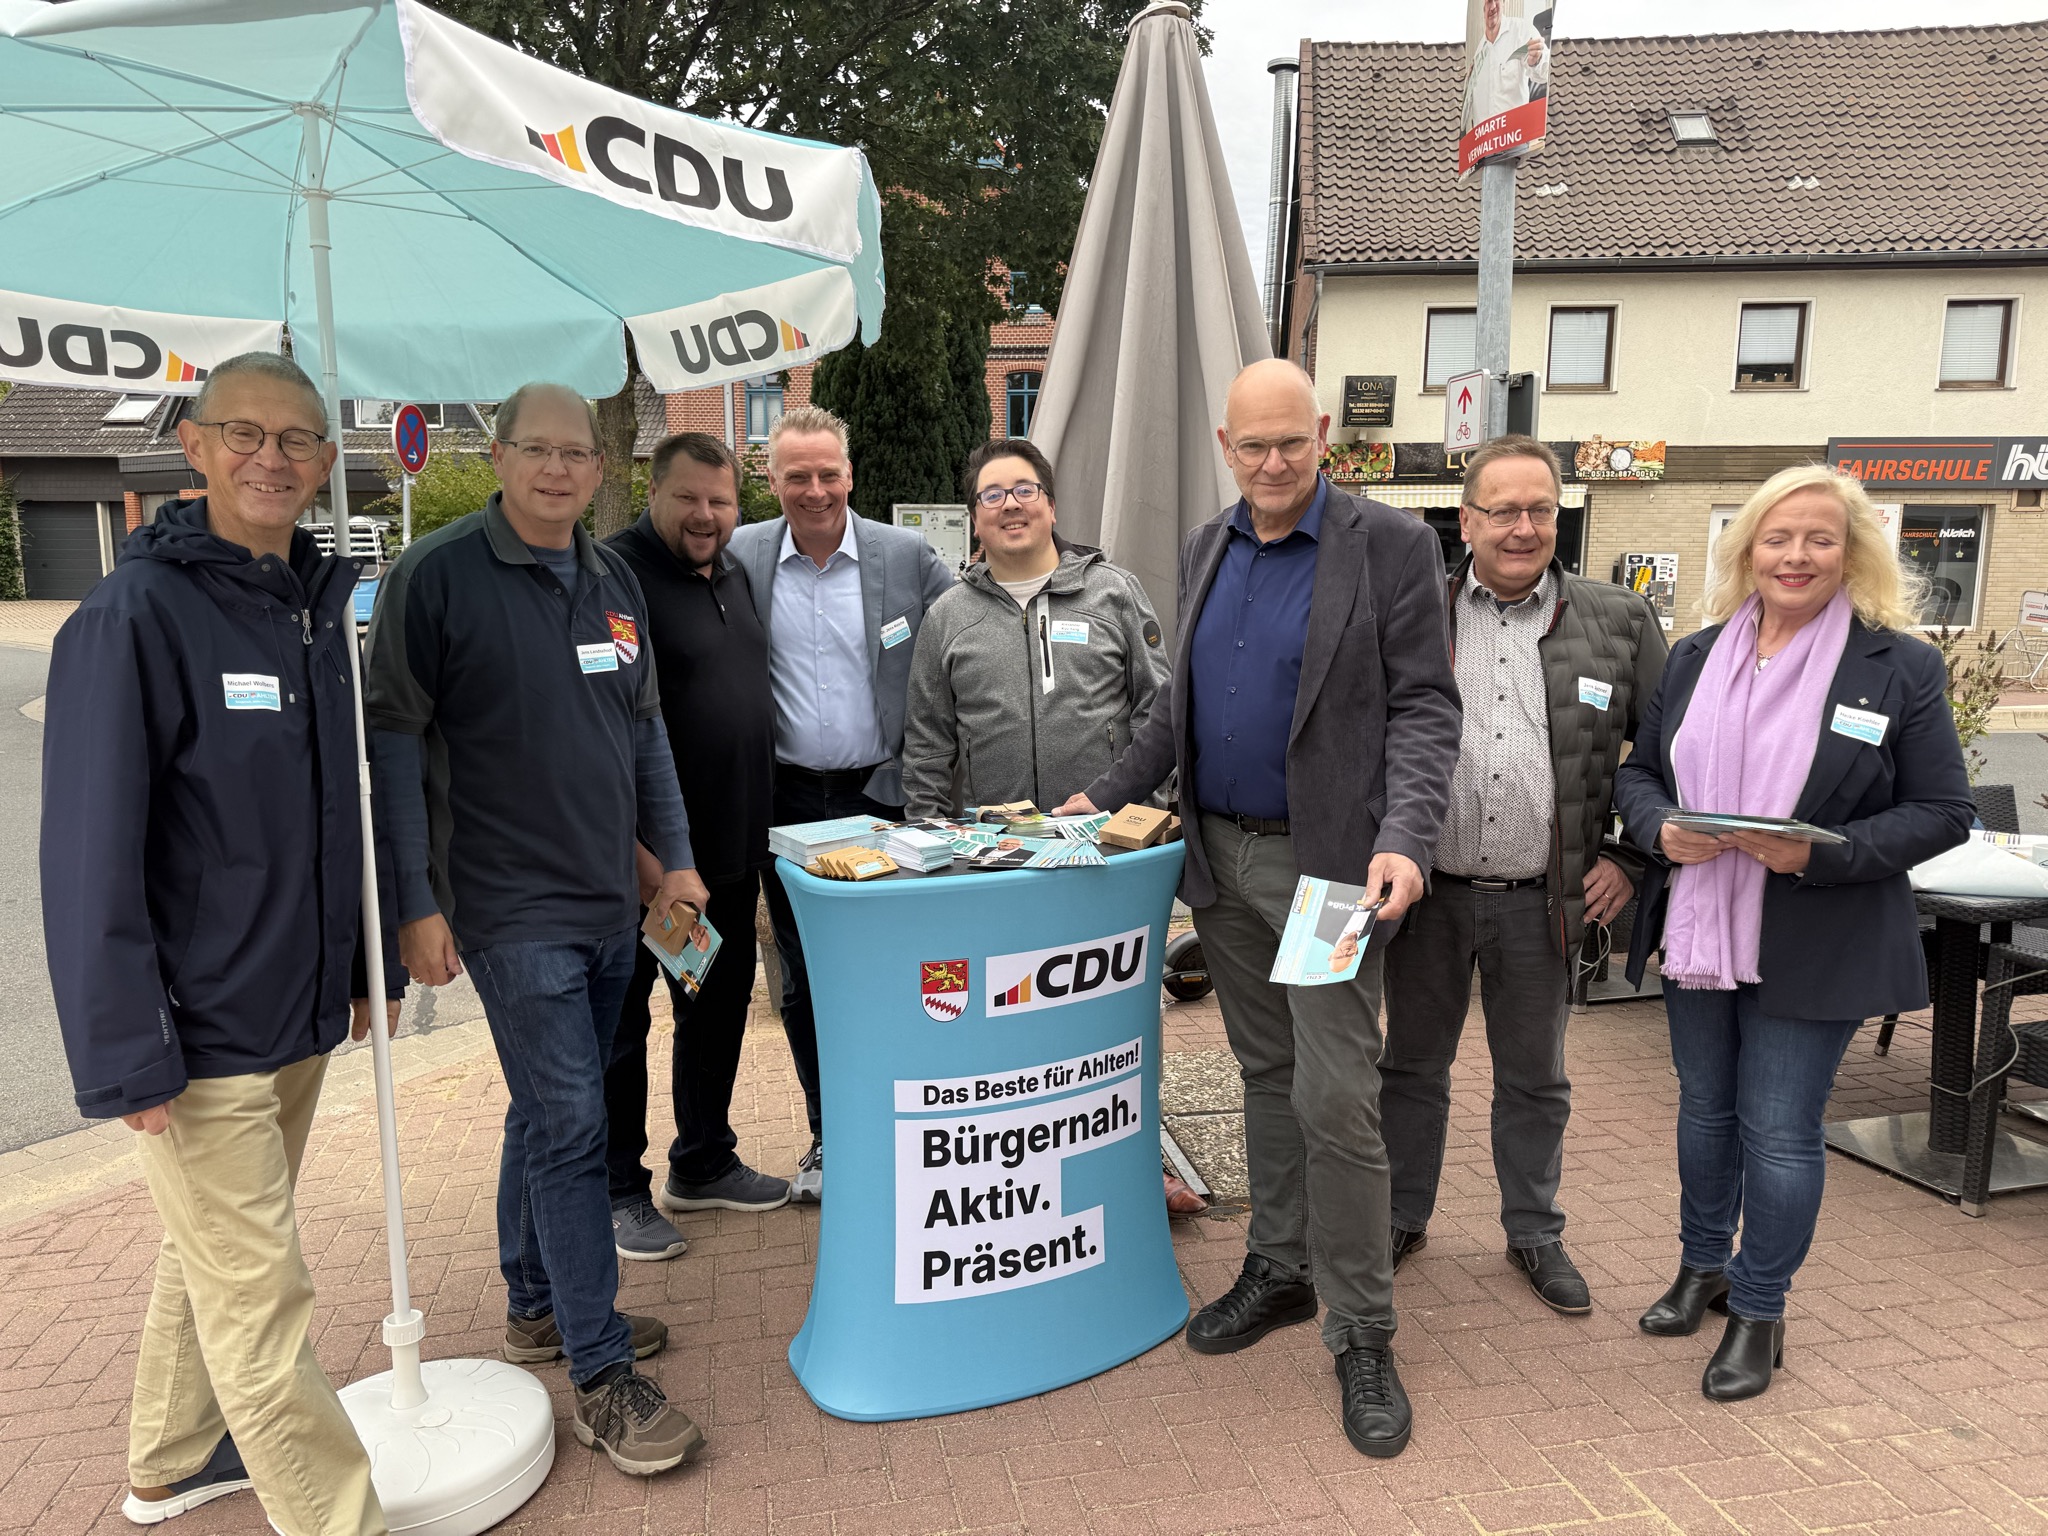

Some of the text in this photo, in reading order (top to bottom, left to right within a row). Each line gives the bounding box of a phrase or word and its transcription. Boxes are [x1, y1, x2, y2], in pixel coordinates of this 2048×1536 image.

[1467, 129, 1522, 164] VERWALTUNG
[1474, 115, 1507, 141] SMARTE
[585, 115, 794, 222] CDU
[1357, 381, 1384, 391] LONA
[1591, 470, 1615, 478] 05132
[1836, 459, 1992, 481] FAHRSCHULE
[252, 680, 275, 689] Wolbers
[1036, 935, 1144, 998] CDU
[923, 1042, 1139, 1106] Das Beste für Ahlten!
[923, 1093, 1137, 1168] Bürgernah.
[924, 1178, 1051, 1229] Aktiv.
[923, 1224, 1097, 1290] Präsent.
